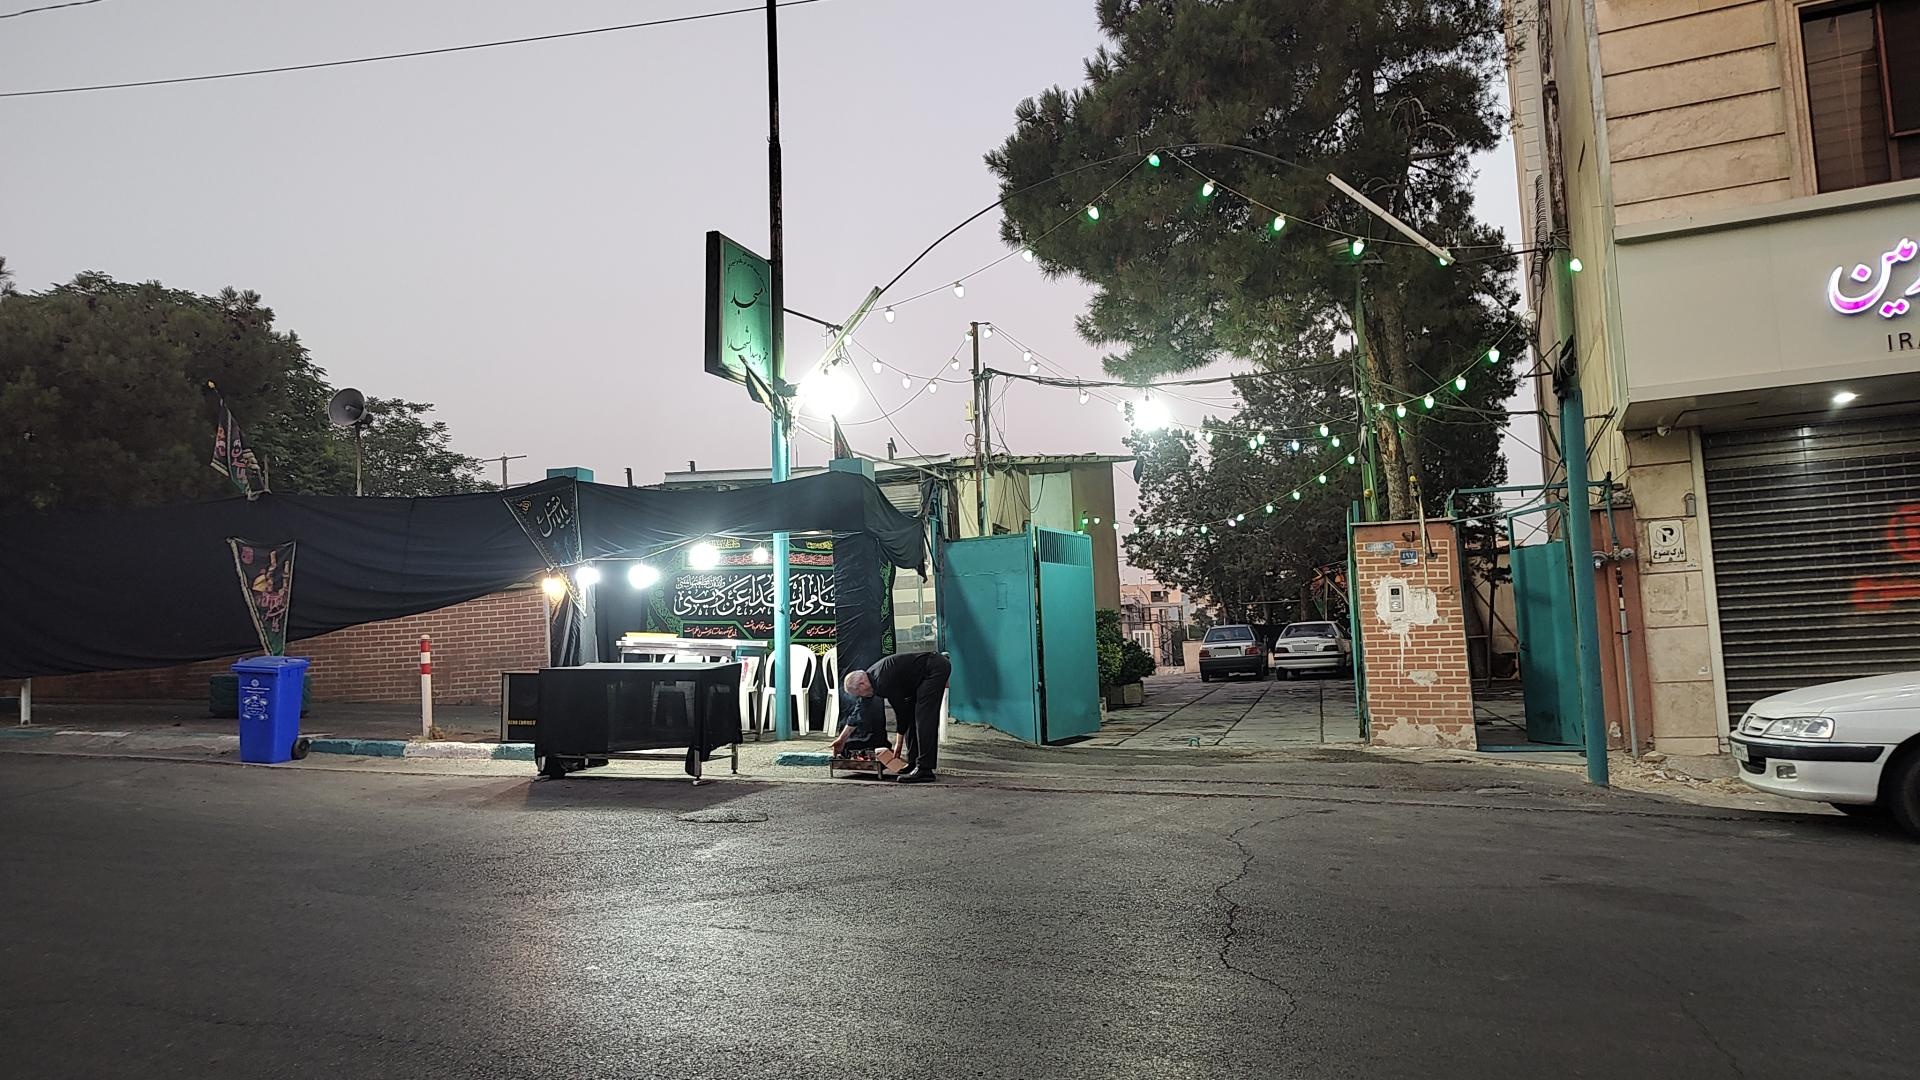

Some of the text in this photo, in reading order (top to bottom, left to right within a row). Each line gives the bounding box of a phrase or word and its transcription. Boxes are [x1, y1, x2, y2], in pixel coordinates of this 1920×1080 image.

[730, 287, 763, 315] مسجد
[1887, 332, 1920, 352] IR
[1653, 547, 1684, 559] پارک ممنوع
